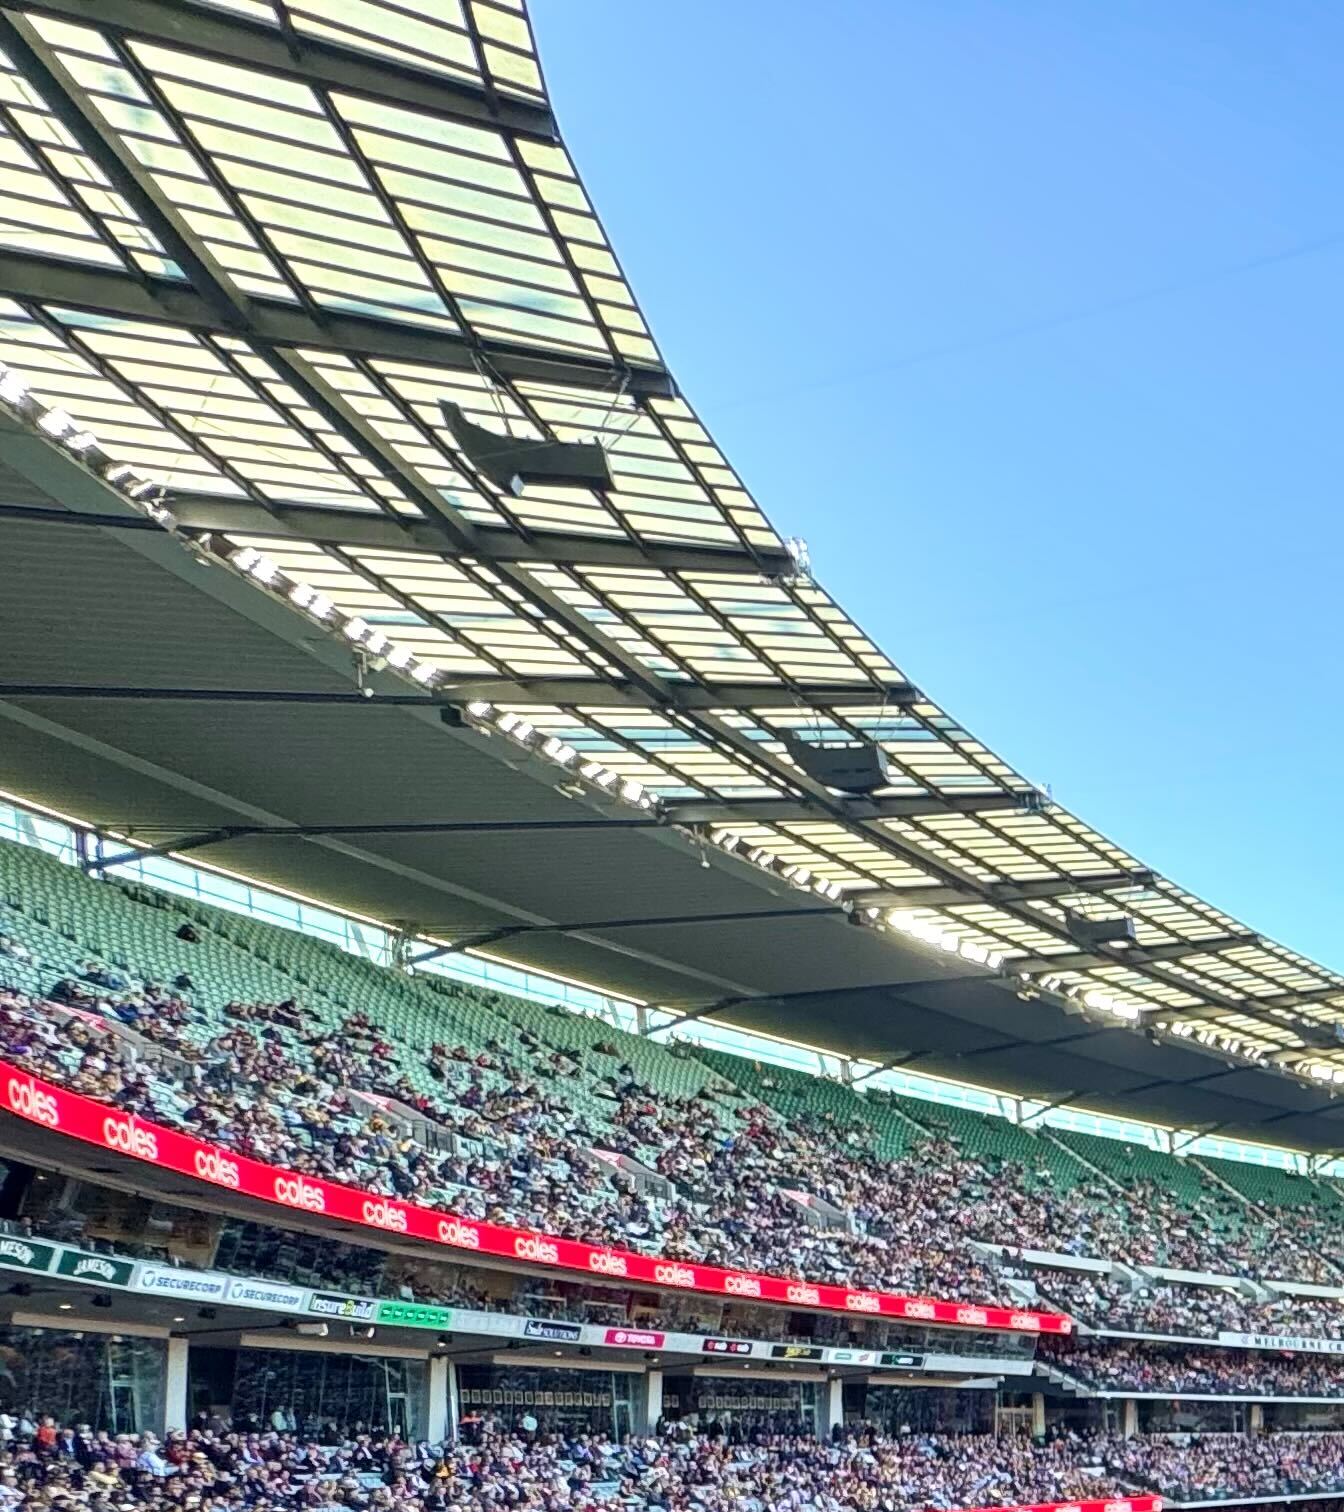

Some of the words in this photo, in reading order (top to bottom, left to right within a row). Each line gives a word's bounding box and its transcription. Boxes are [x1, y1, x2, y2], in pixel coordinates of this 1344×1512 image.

[8, 1076, 59, 1126] coles
[103, 1115, 158, 1159] coles
[194, 1147, 240, 1187] coles
[274, 1174, 325, 1211] coles
[363, 1199, 407, 1232] coles
[438, 1218, 479, 1248] coles
[514, 1234, 559, 1263] coles
[589, 1248, 627, 1276] coles
[156, 1277, 222, 1294] SECURECORP
[655, 1262, 695, 1287] coles
[725, 1272, 761, 1297] coles
[242, 1289, 300, 1306] SECURECORP
[787, 1281, 820, 1305] coles
[1254, 1337, 1322, 1350] MELBOURNE
